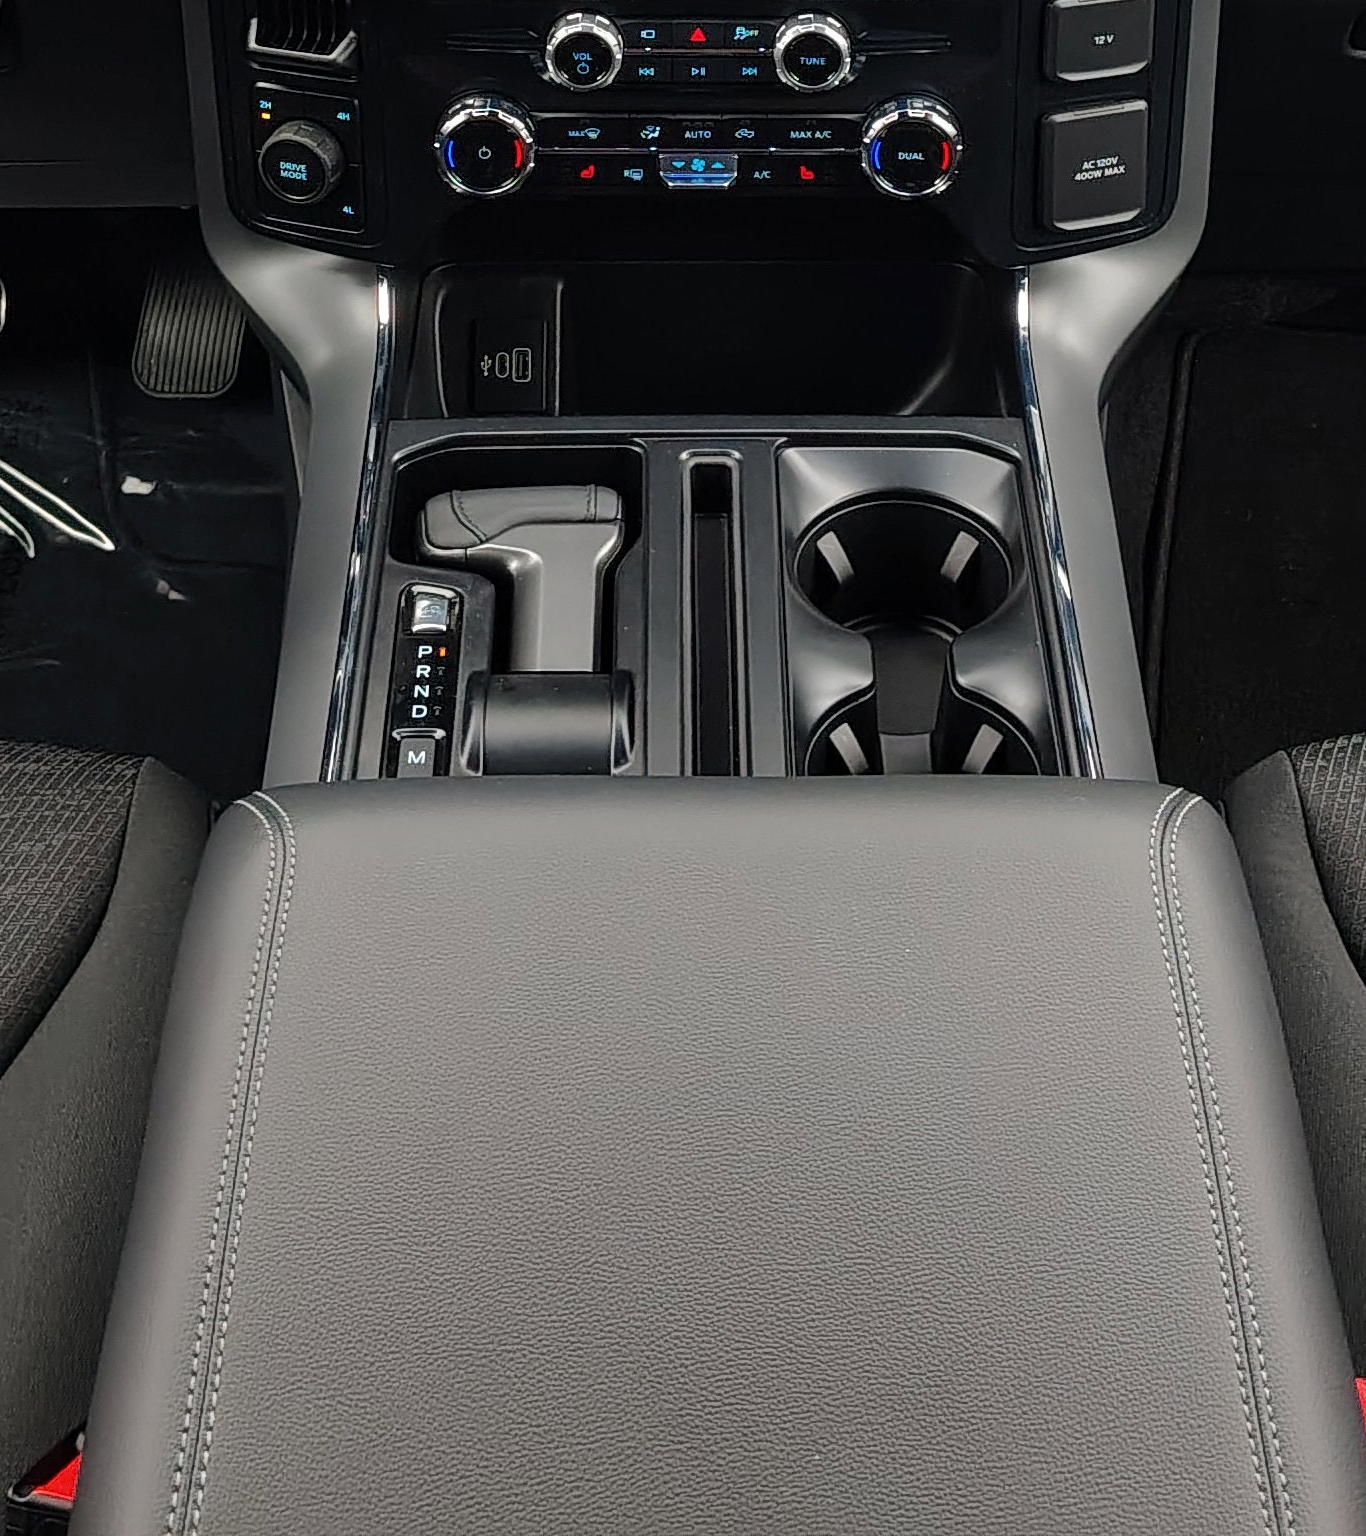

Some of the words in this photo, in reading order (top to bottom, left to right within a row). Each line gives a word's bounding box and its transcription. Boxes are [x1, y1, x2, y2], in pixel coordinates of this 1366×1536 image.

[1094, 35, 1105, 45] 12
[1105, 35, 1115, 44] V
[572, 52, 593, 61] VOL
[799, 57, 827, 65] TUNE
[259, 100, 272, 110] 2H
[336, 112, 350, 121] 4H
[684, 130, 712, 139] AUTO
[790, 130, 813, 139] MAX
[814, 130, 833, 139] A/C
[897, 151, 925, 160] DUAL
[279, 161, 308, 173] DRIVE
[1082, 159, 1096, 170] AC
[1096, 156, 1119, 167] 120V
[280, 170, 308, 181] MODE
[753, 170, 772, 179] A/C
[1074, 168, 1103, 181] 400W
[1104, 165, 1126, 176] MAX
[342, 205, 355, 215] 4L
[417, 645, 433, 659] P
[415, 664, 432, 679] R
[413, 684, 430, 698] N
[411, 704, 428, 719] D
[407, 750, 426, 764] M
